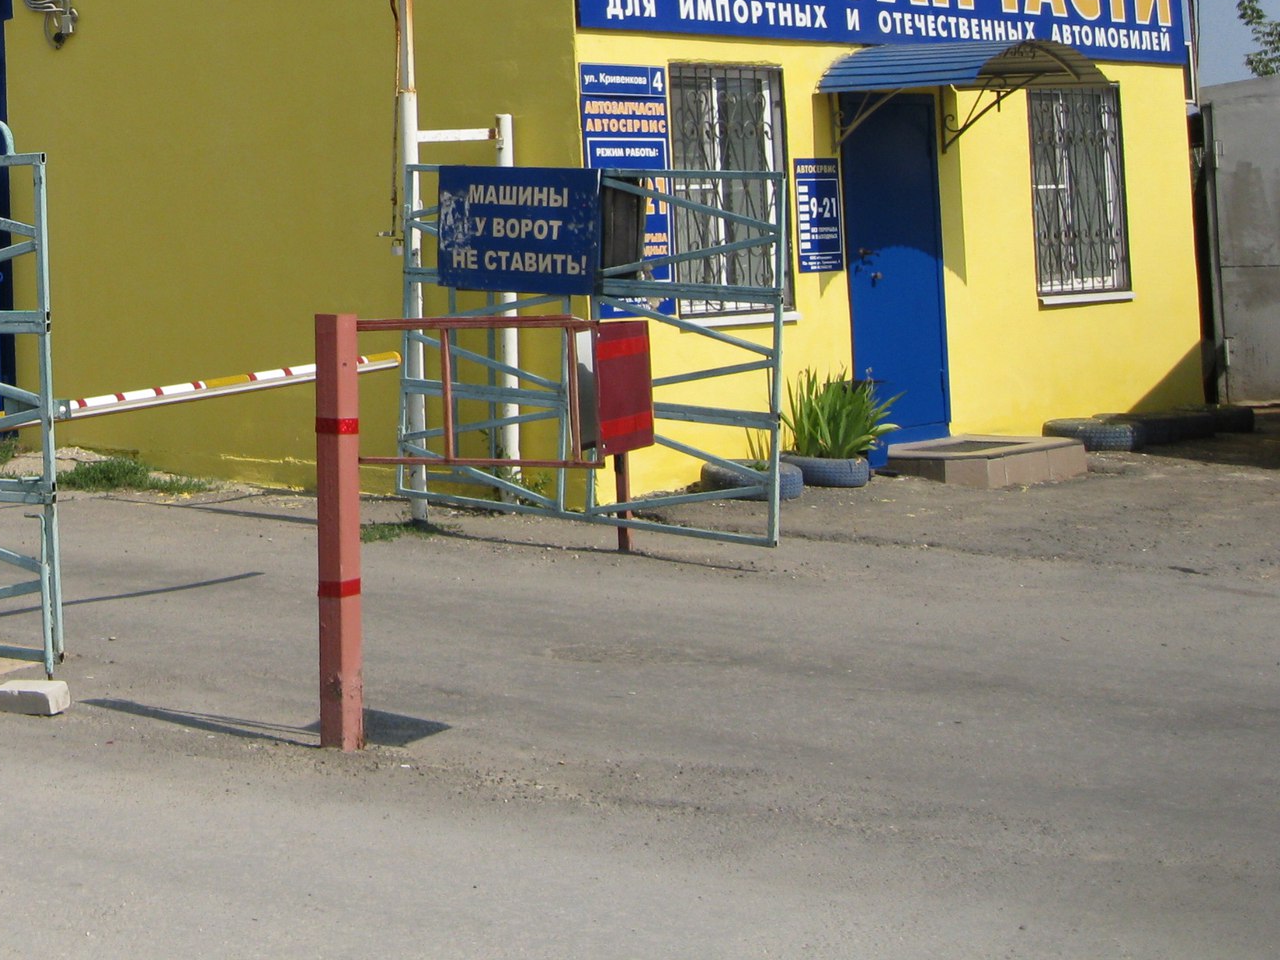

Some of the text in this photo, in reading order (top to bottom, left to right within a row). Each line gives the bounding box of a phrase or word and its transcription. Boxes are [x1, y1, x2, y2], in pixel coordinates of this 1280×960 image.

[846, 8, 860, 31] И
[878, 10, 1036, 41] ОТЕЧЕСТВЕННЫХ
[1050, 23, 1171, 52] АВТОМОБИЛЕЙ
[584, 71, 663, 92] ул. Кривенкова 4
[584, 101, 665, 116] АВТОЗАПЧАСТИ
[586, 118, 666, 133] АВТОСЕРВИС
[596, 148, 659, 157] РЕЖИМ РАБОТЫ:
[796, 165, 836, 173] АВТОСЕРВИС
[469, 184, 568, 207] МАШИНЫ
[810, 197, 837, 218] 9-21
[475, 217, 562, 240] У ВОРОТ
[452, 249, 587, 275] НЕ СТАВИТЬ!
